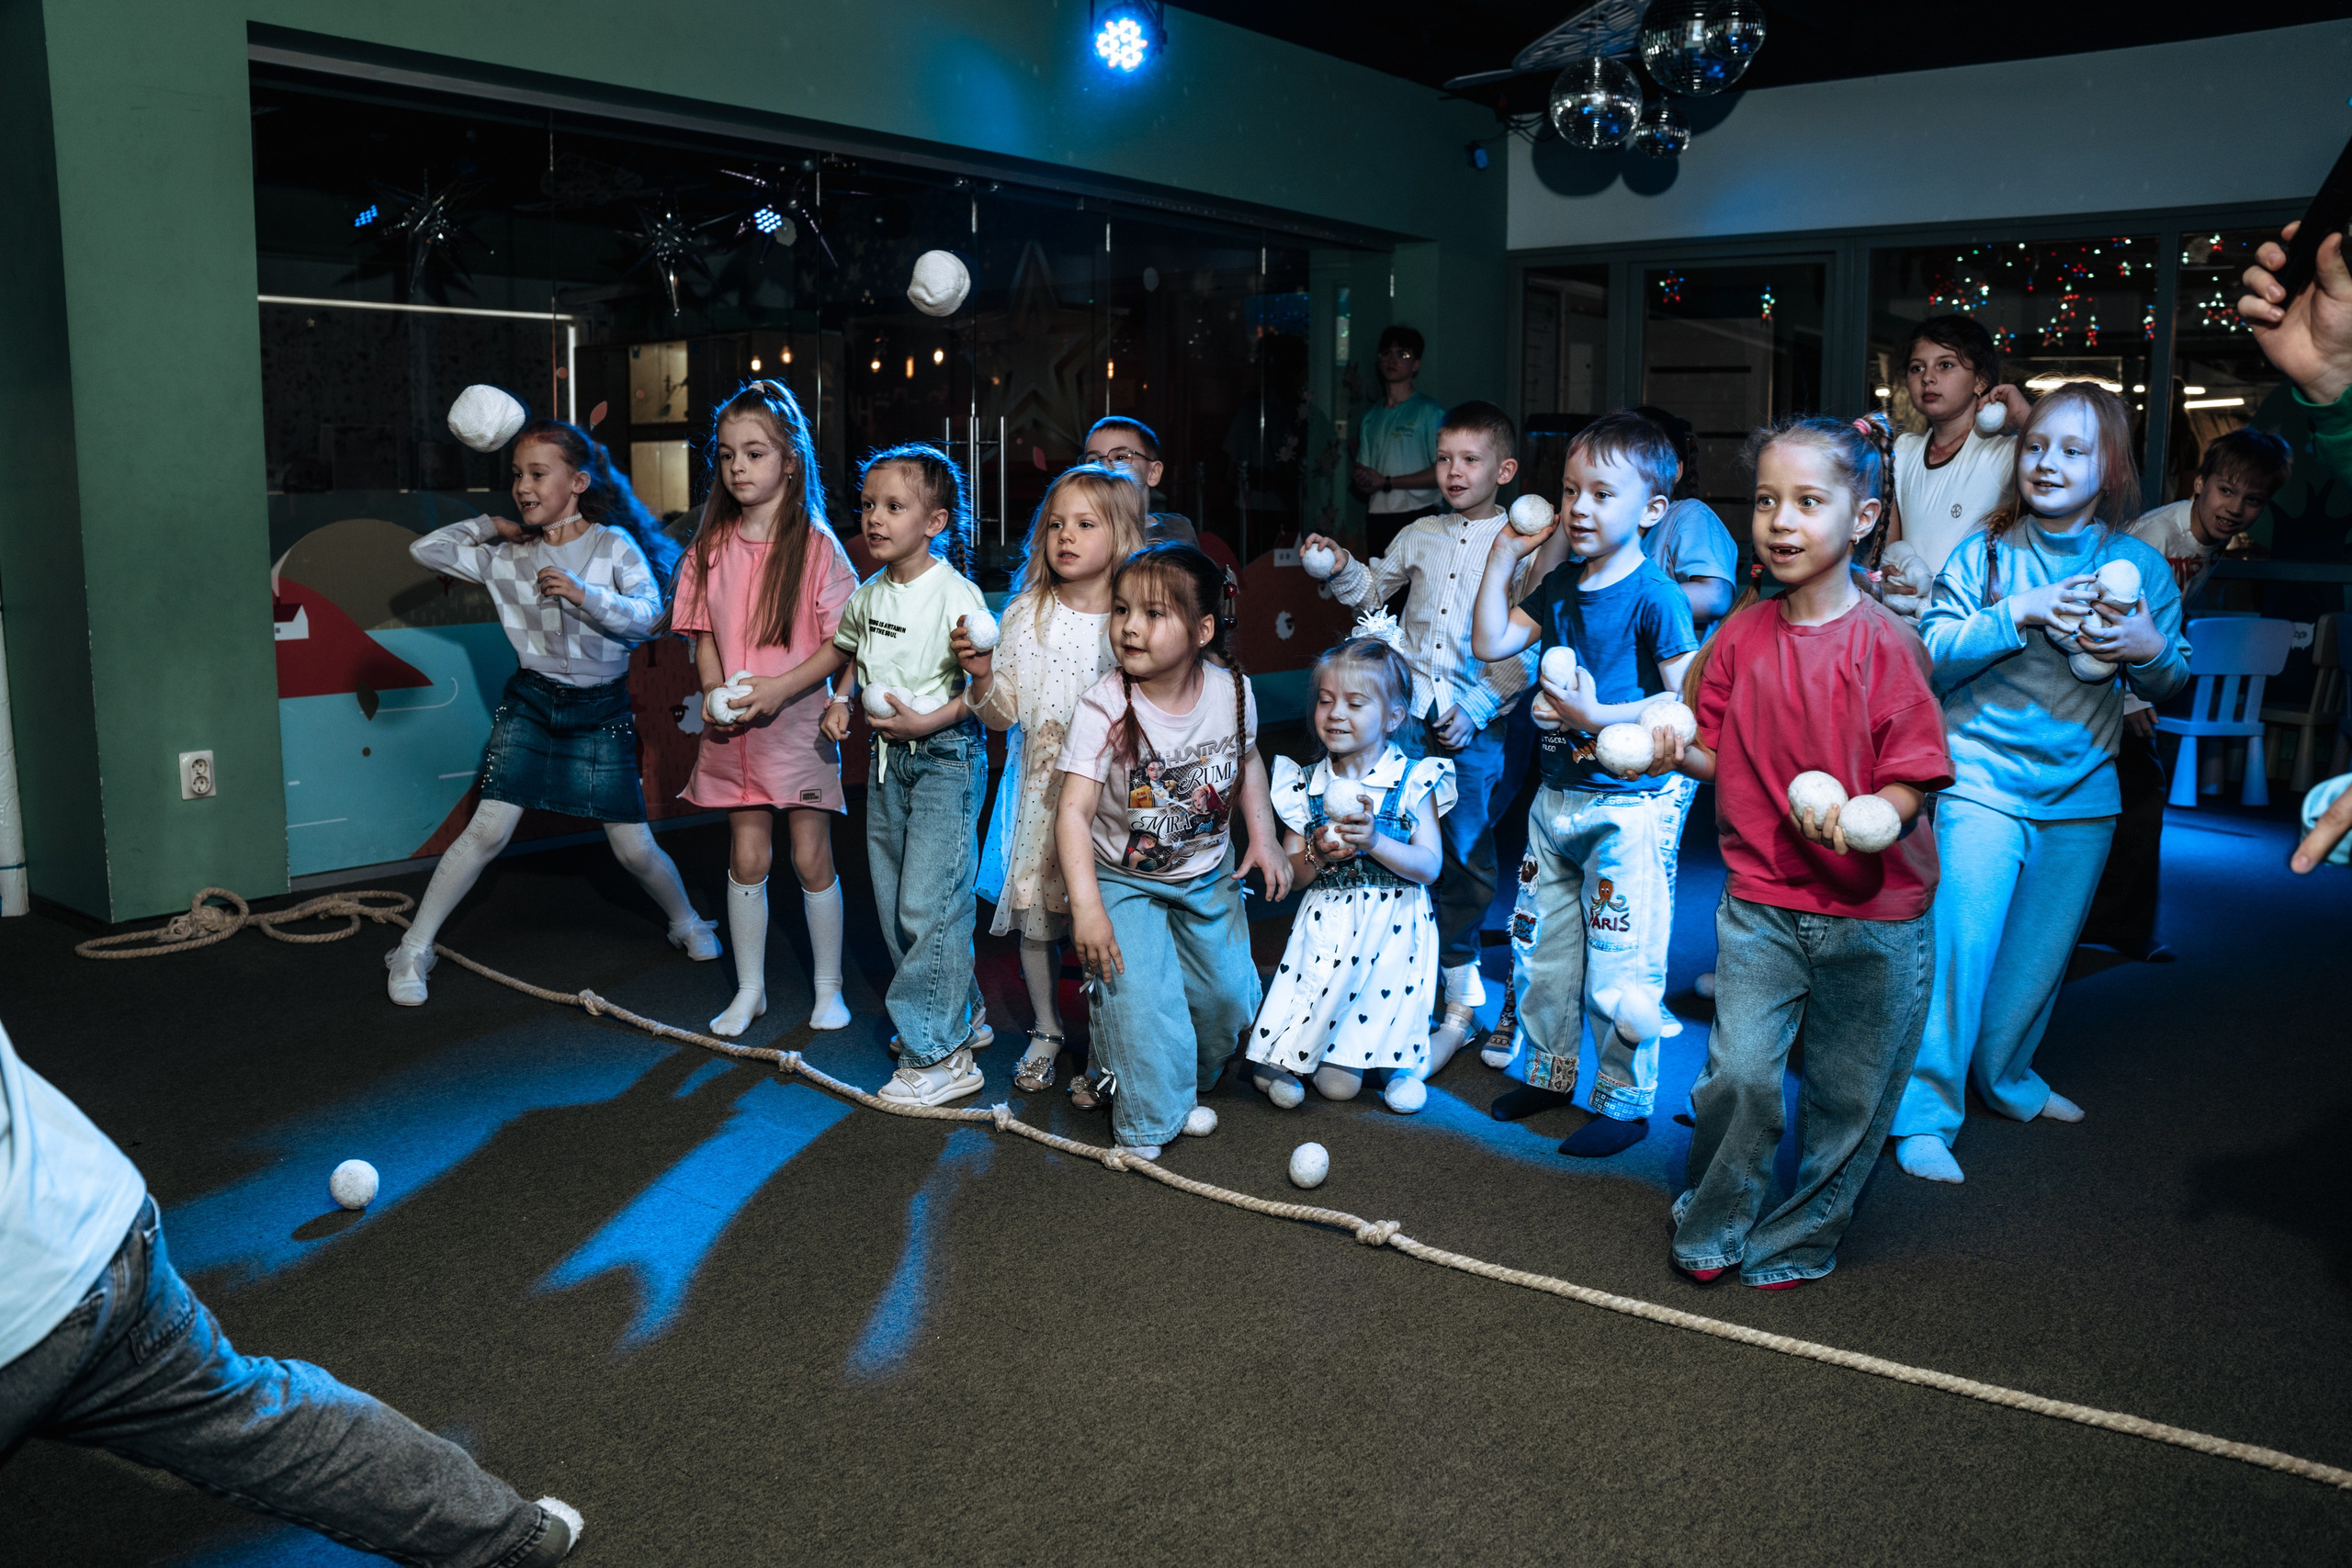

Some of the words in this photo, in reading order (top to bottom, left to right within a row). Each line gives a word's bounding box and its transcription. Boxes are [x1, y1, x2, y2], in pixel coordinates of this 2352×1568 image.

[885, 630, 897, 638] SOUL
[1544, 736, 1566, 745] TIGERS
[1177, 761, 1232, 795] RUMI
[1131, 813, 1193, 840] MIRA
